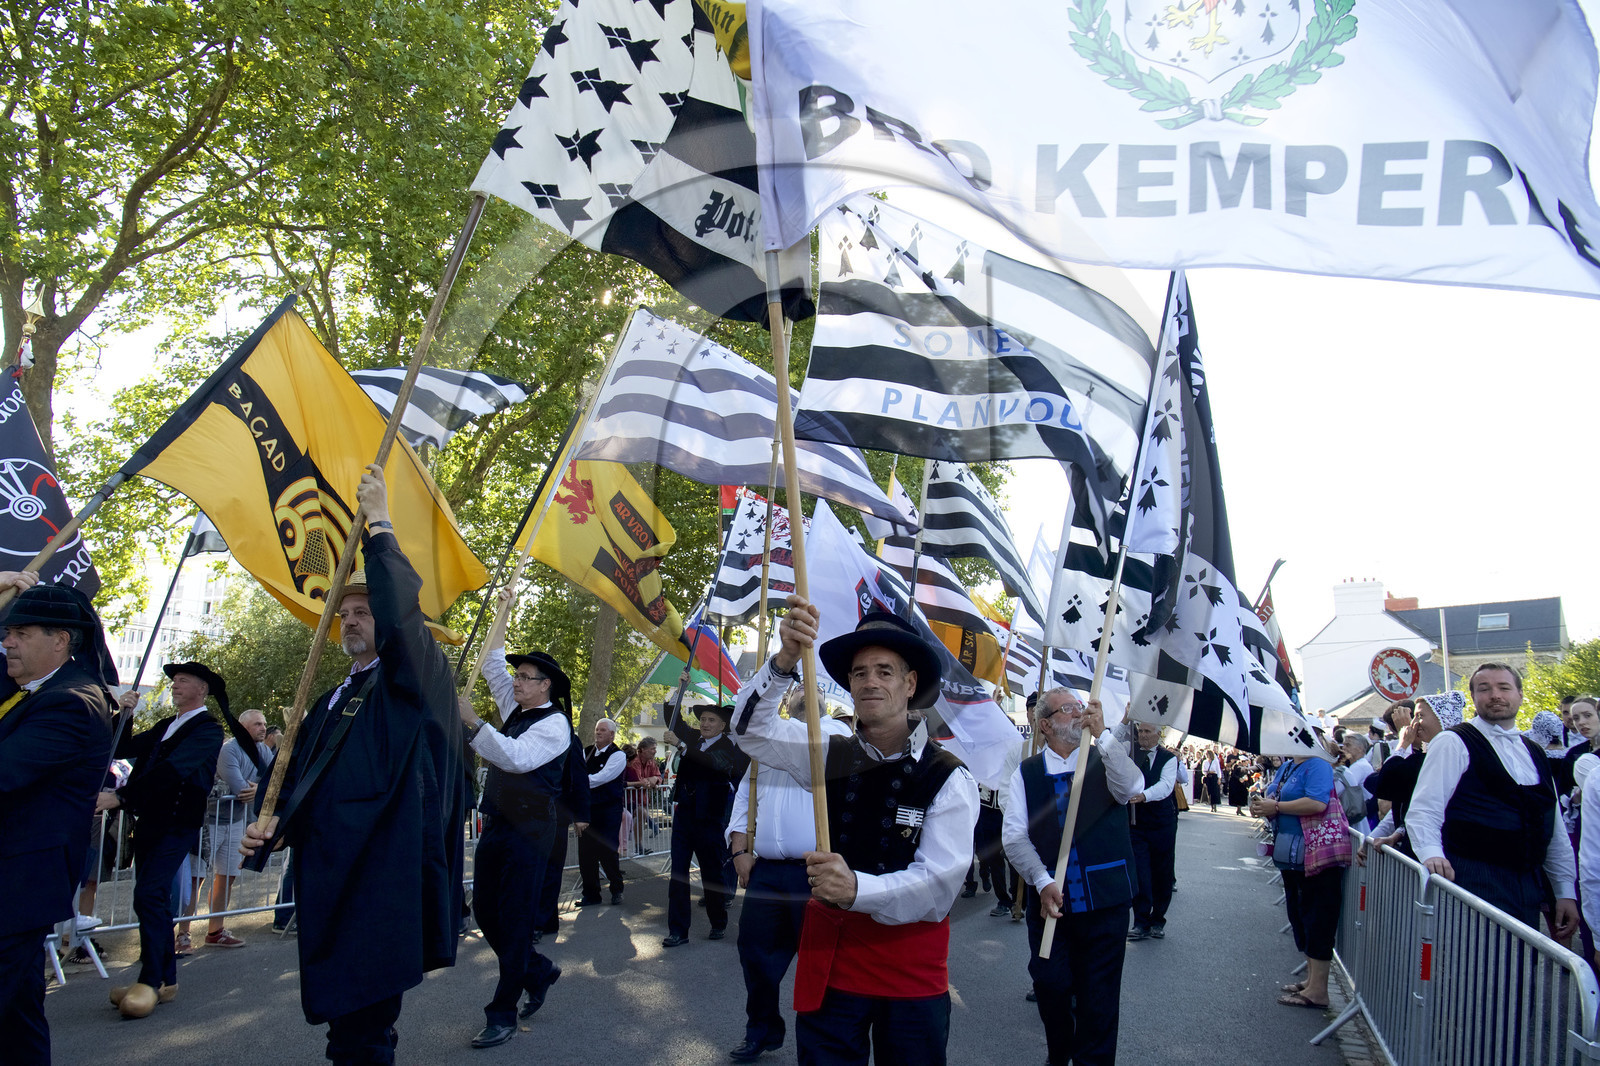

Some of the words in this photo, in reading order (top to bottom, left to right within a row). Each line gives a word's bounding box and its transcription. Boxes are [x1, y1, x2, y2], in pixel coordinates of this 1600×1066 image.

[799, 84, 993, 191] BRO
[893, 322, 1033, 357] SONE
[228, 382, 286, 472] BAGAD
